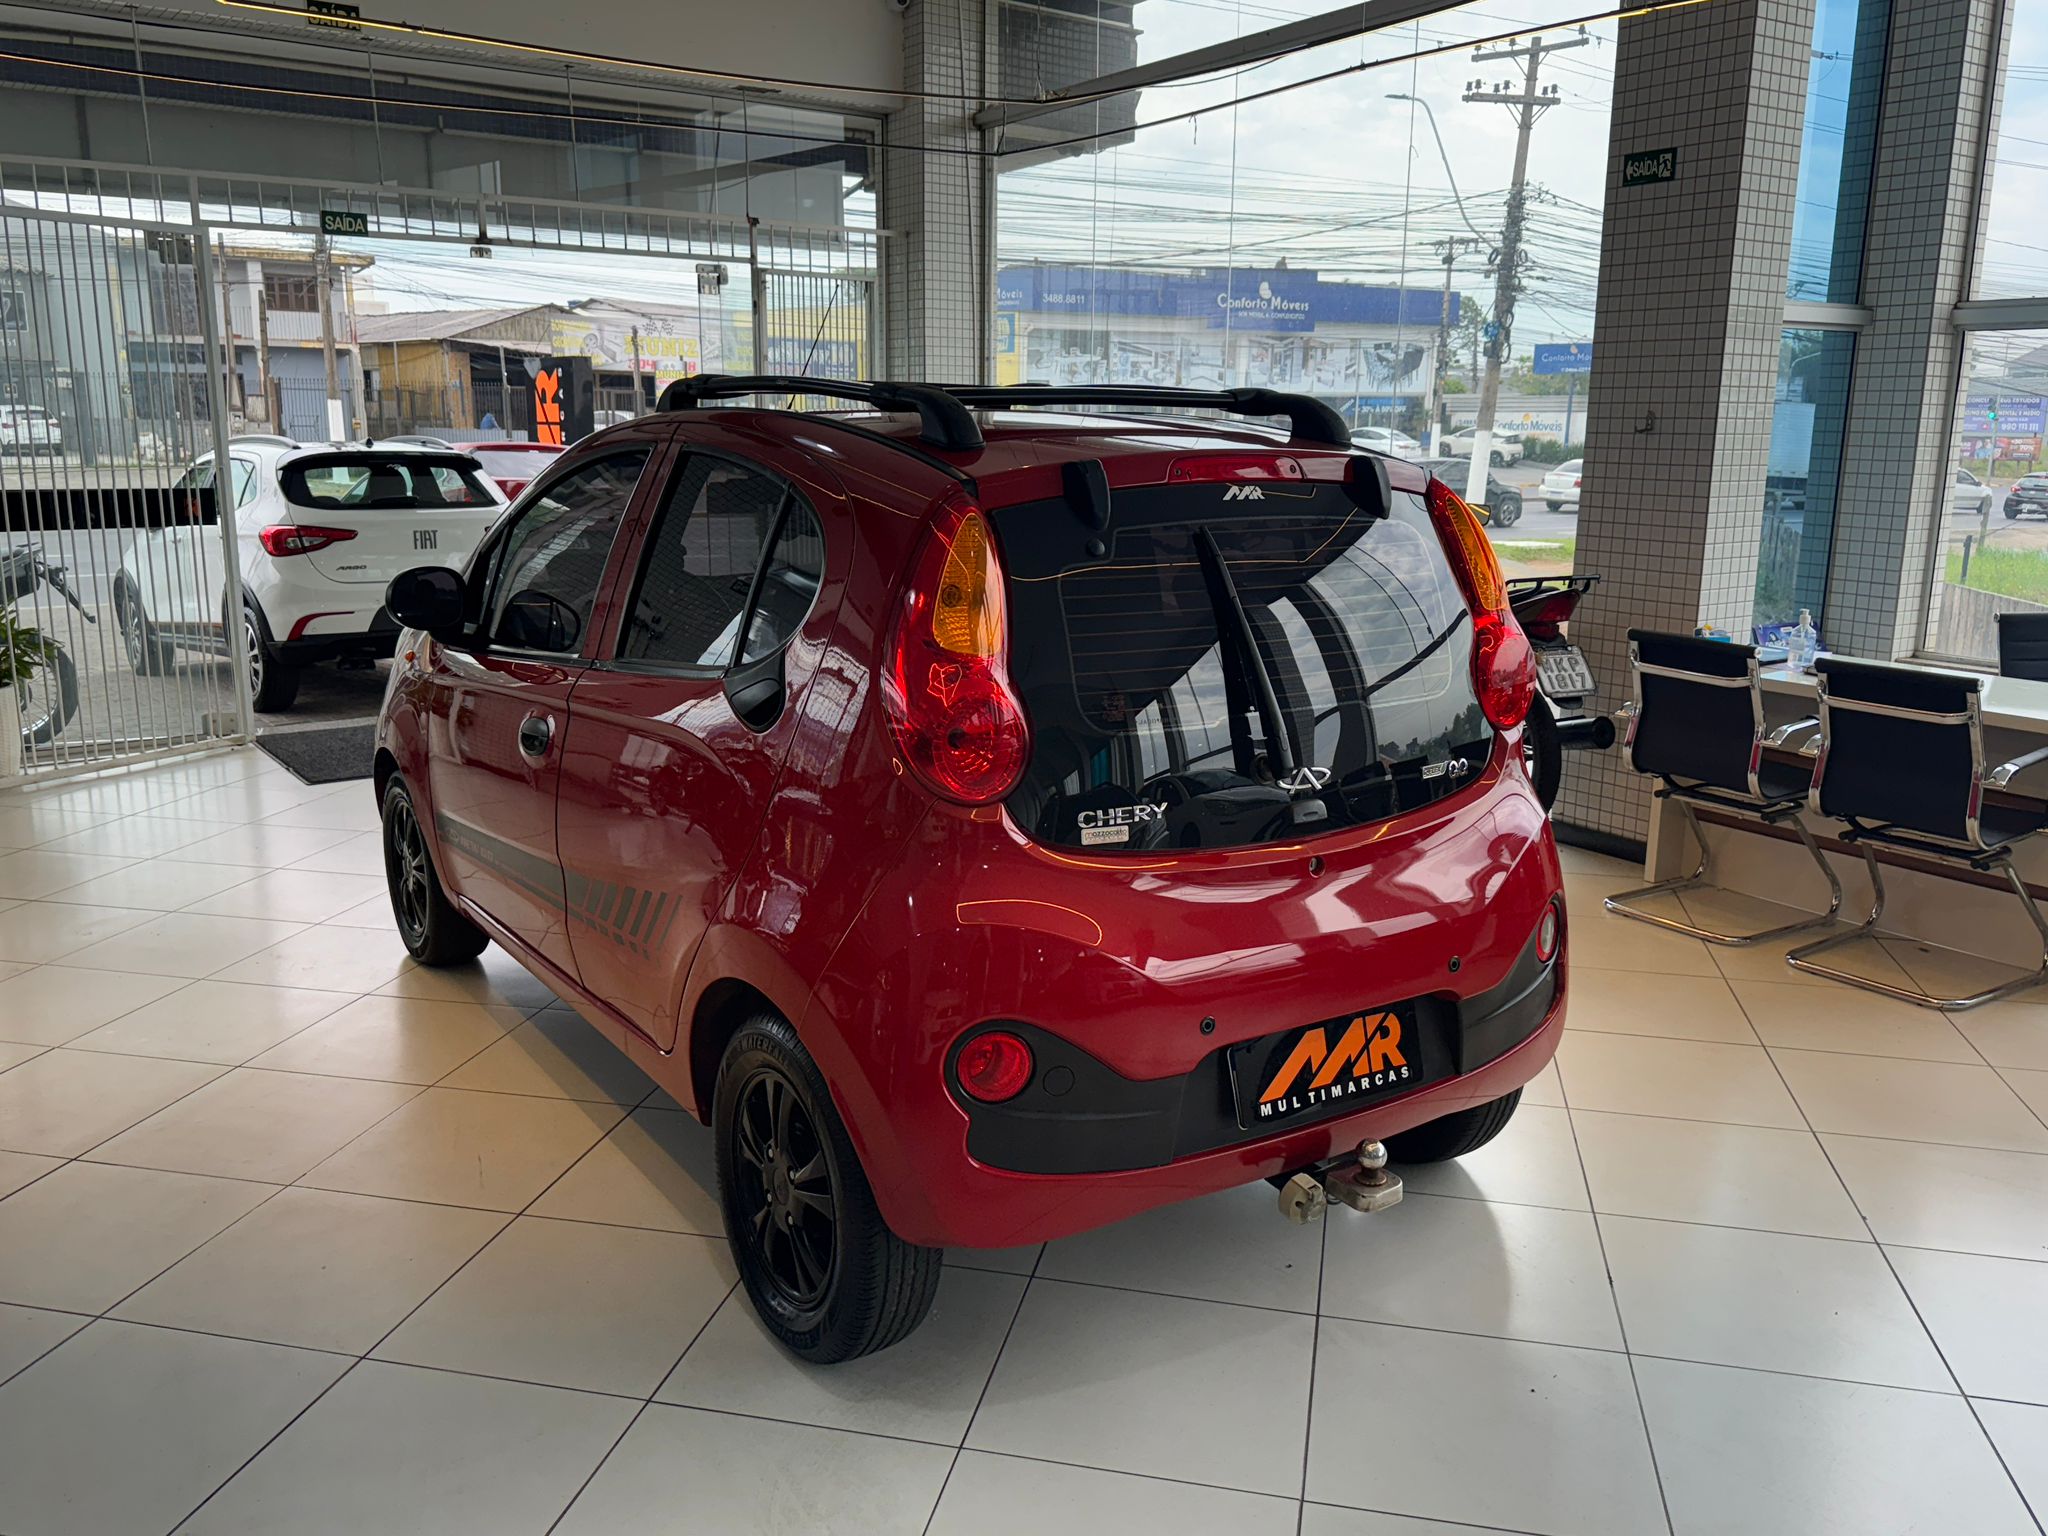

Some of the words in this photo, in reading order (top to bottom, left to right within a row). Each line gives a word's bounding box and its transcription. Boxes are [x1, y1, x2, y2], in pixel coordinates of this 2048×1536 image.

[1632, 156, 1658, 177] SAÍDA
[325, 213, 366, 233] SAÍDA
[1216, 293, 1268, 310] Conforto
[1270, 296, 1310, 311] Móveis
[1530, 419, 1563, 432] Móveis
[413, 529, 439, 550] FIAT
[1541, 657, 1580, 674] MKP
[1547, 673, 1586, 690] 1817
[1077, 802, 1168, 829] CHERY
[1260, 1066, 1410, 1117] MULTIMARCAS
